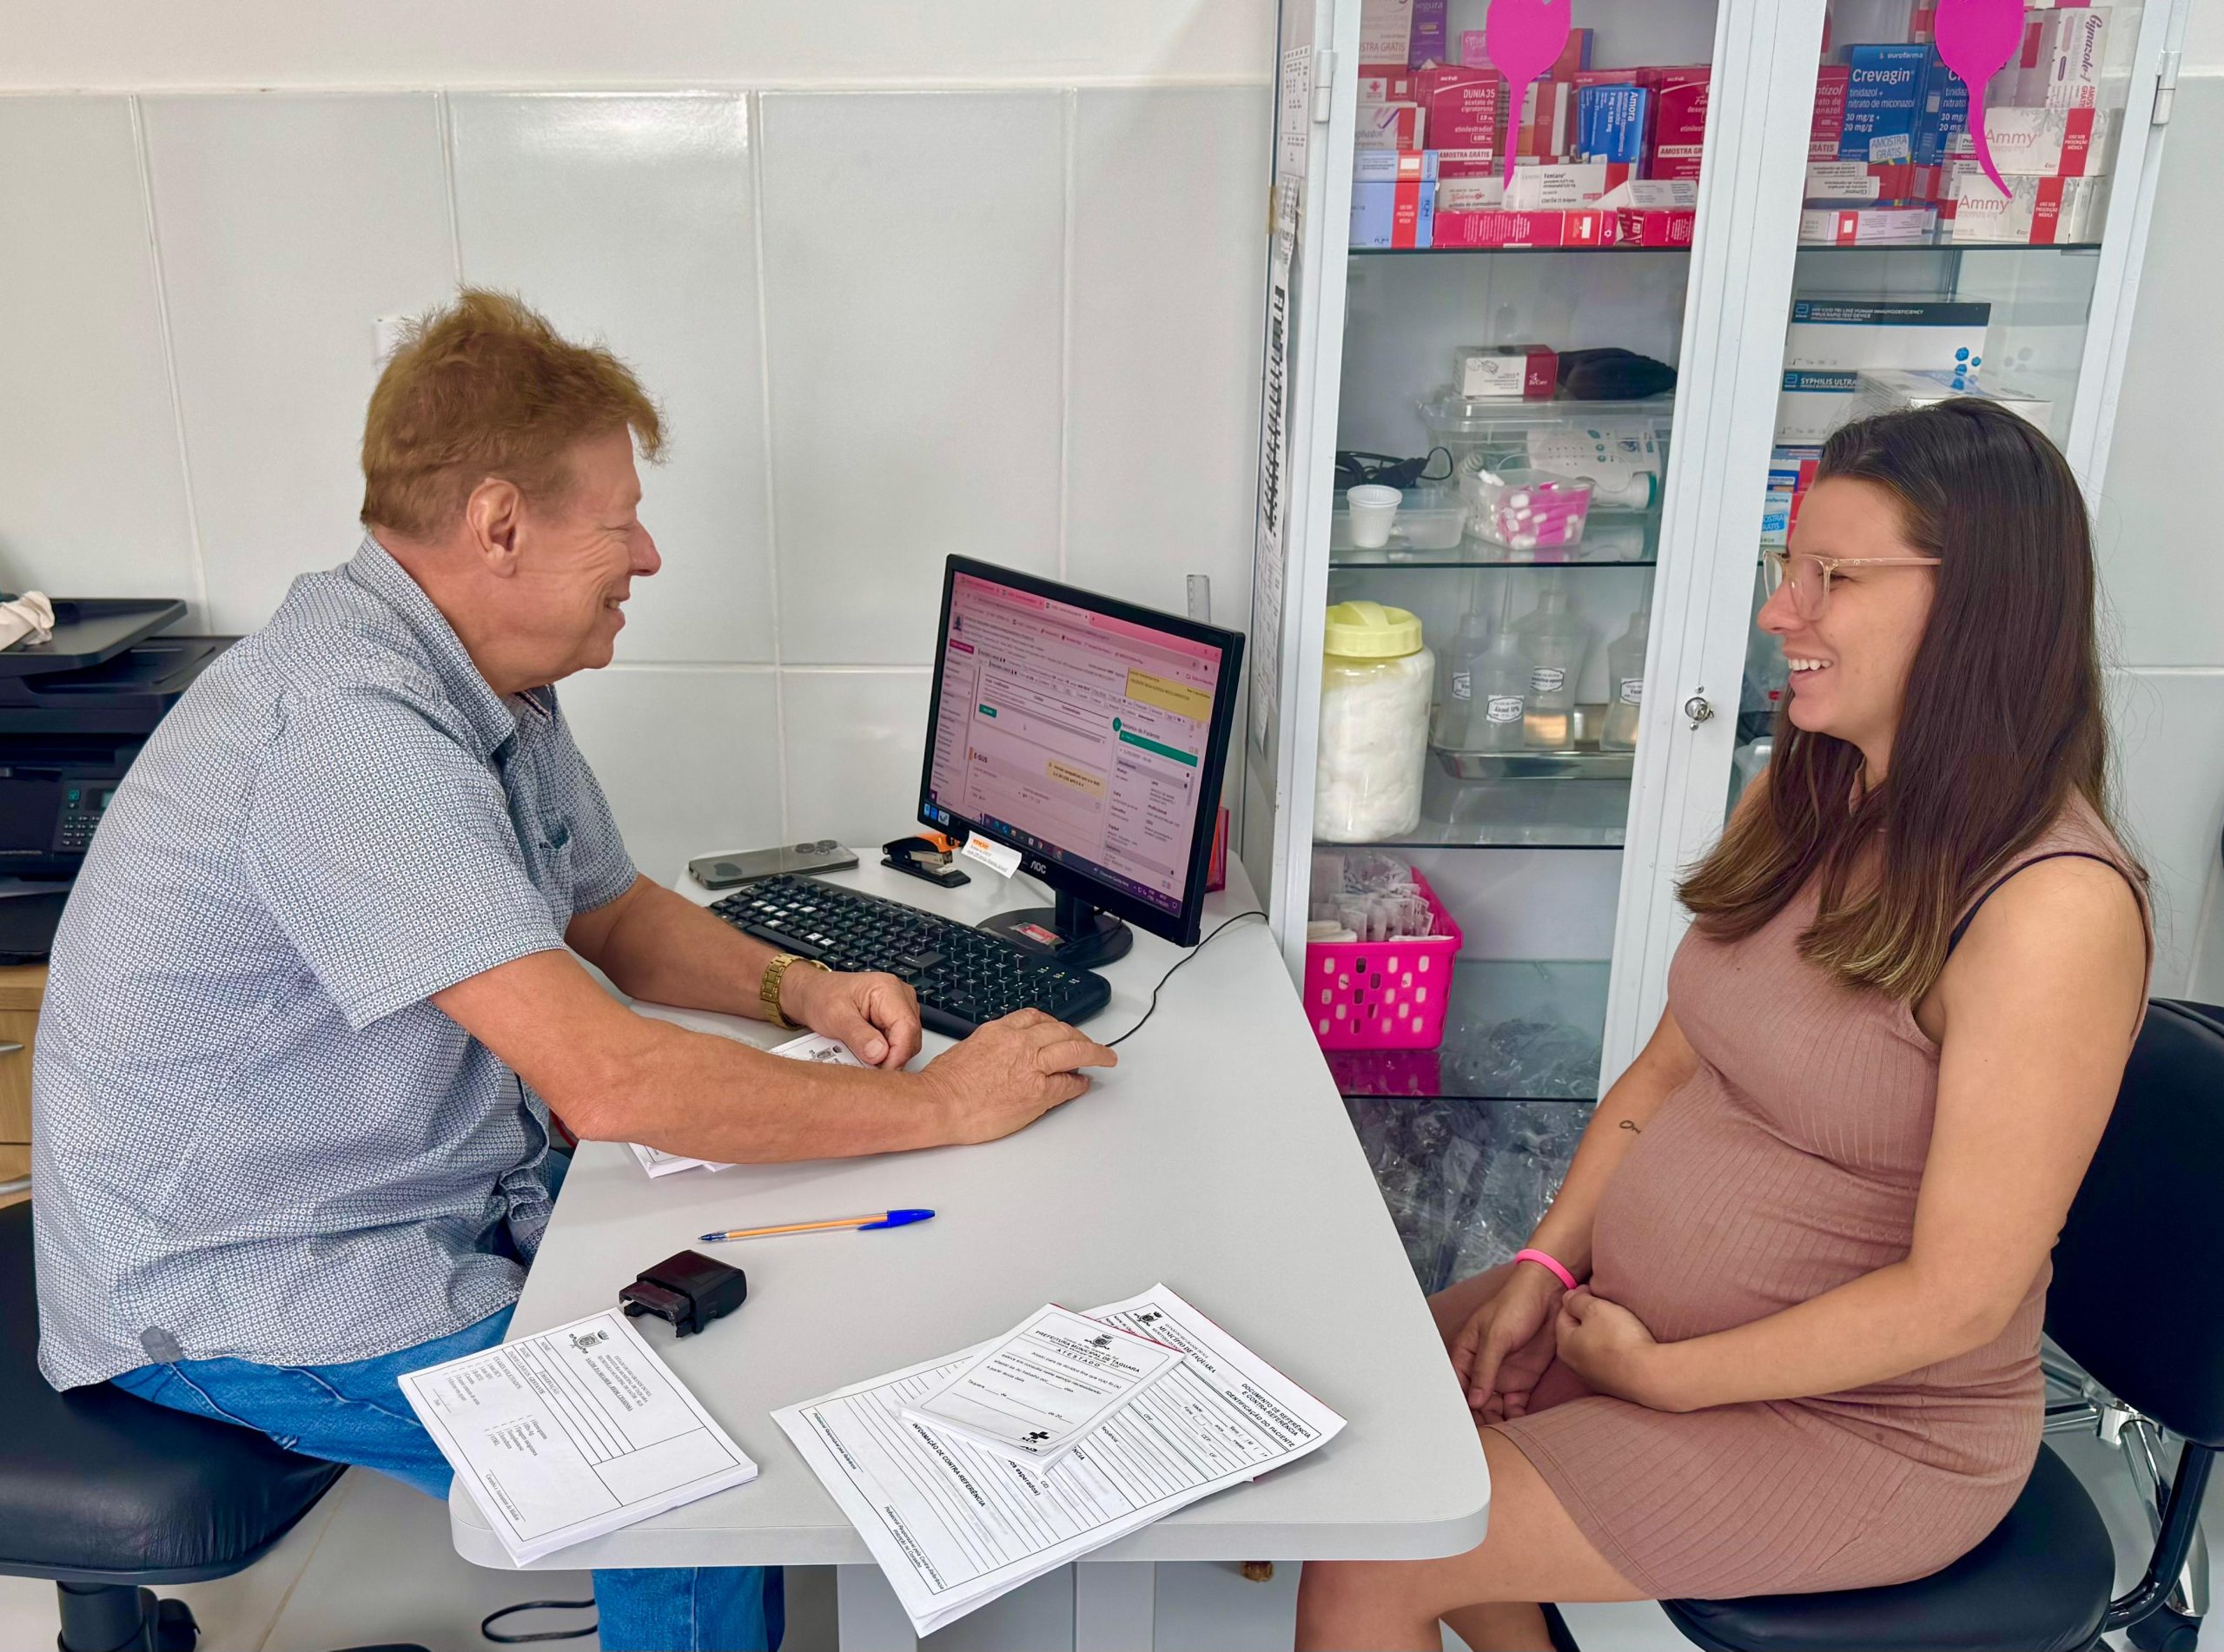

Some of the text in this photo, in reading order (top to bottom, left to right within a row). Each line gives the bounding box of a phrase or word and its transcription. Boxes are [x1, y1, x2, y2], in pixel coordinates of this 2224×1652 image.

[2080, 15, 2102, 83] Gynazole-1
[1852, 67, 1910, 85] Crevagin
[1463, 89, 1495, 99] DUNIA 35
[1850, 87, 1877, 97] tinidazol
[1627, 91, 1638, 122] Amora
[1870, 99, 1880, 108] de
[1881, 98, 1915, 108] miconazol
[1943, 99, 1966, 108] nitrato
[1845, 113, 1855, 122] 30
[1856, 114, 1874, 122] mg/g
[1854, 124, 1873, 133] mg/g
[1871, 135, 1907, 148] AMOSTRA
[1985, 129, 2036, 148] Ammy
[1876, 148, 1902, 160] GRÁTIS
[1958, 195, 2009, 215] Ammy
[973, 750, 988, 764] E-SUS
[1030, 860, 1047, 875] AOC
[1035, 1330, 1070, 1346] PREFEITURA
[1070, 1343, 1102, 1358] MUNICIPAL
[1111, 1358, 1141, 1373] TAQUARA
[1159, 1326, 1186, 1347] MUNICÍPIO
[1191, 1352, 1216, 1373] TAQUARA
[1023, 1361, 1043, 1372] consulta
[1055, 1374, 1072, 1384] serviço
[1225, 1391, 1262, 1420] IDENTIFICAÇÃO
[1269, 1426, 1295, 1447] PACIENTE
[1241, 1384, 1273, 1407] DOCUMENTO
[1279, 1412, 1311, 1438] REFERÊNCIA
[1247, 1395, 1298, 1436] CONTRA-REFERÊNCIA
[1102, 1426, 1118, 1443] Sequência
[912, 1424, 938, 1450] INFORMAÇÃO
[943, 1456, 985, 1507] CONTRA-REFERÊNCIA
[1016, 1469, 1041, 1496] esperados)
[884, 1506, 900, 1525] Profissional
[898, 1524, 917, 1548] Responsável
[912, 1548, 921, 1556] pela
